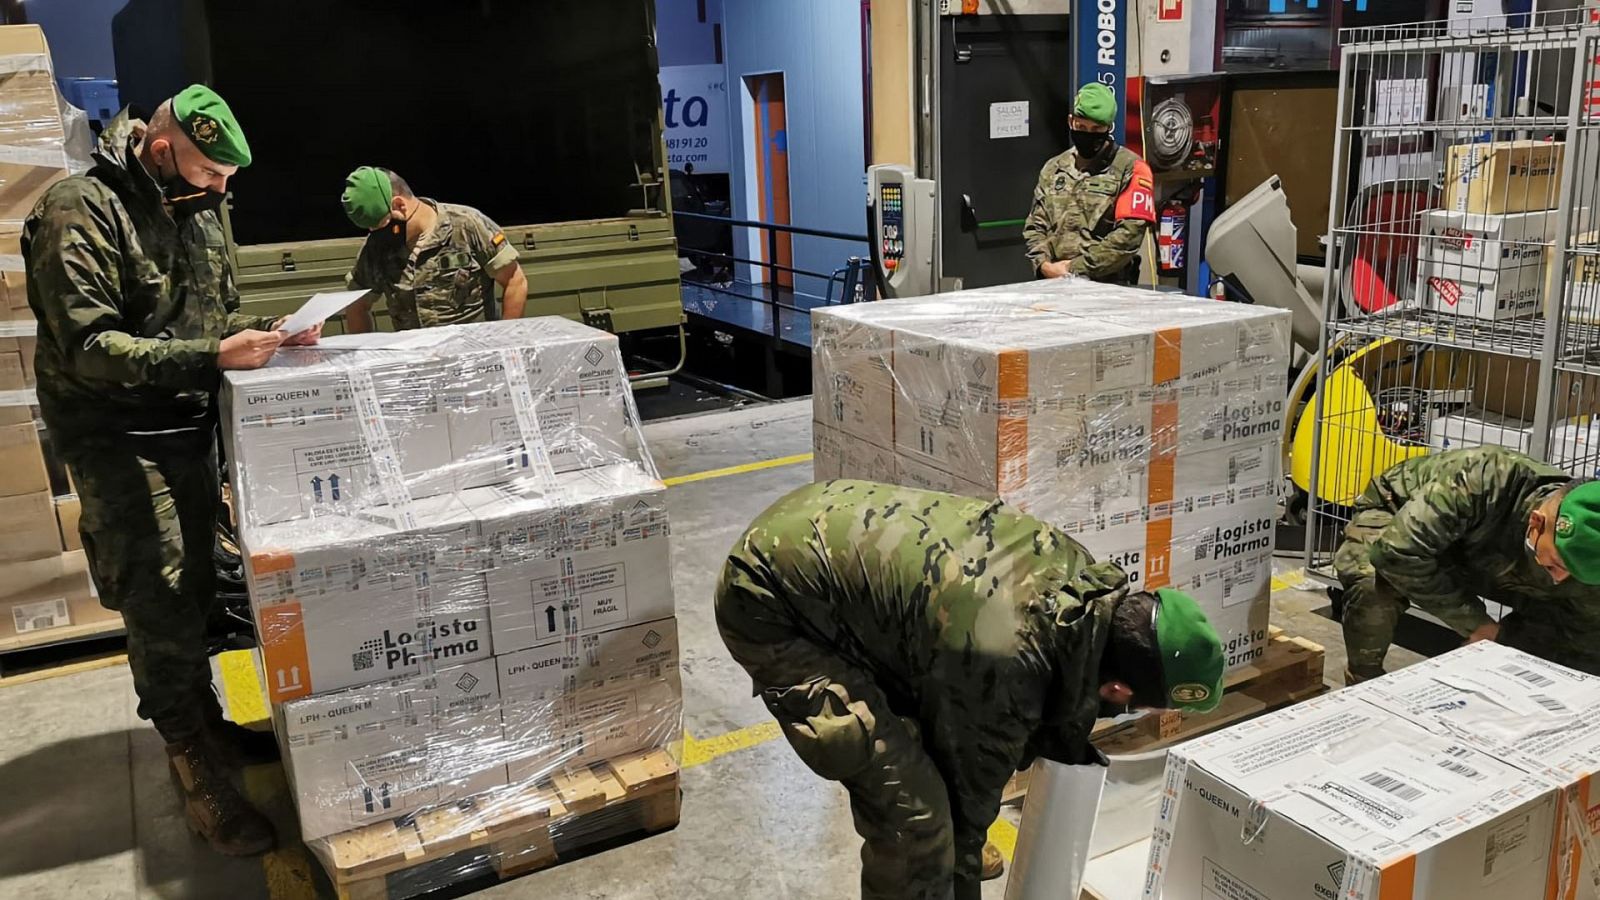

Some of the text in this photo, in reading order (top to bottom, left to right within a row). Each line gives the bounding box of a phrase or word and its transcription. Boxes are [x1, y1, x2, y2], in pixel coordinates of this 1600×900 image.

[664, 89, 708, 128] ta
[667, 137, 708, 149] 819120
[248, 393, 268, 405] LPH
[276, 390, 309, 403] QUEEN
[311, 388, 320, 397] M
[1223, 400, 1282, 423] Logista
[1222, 418, 1281, 441] Pharma
[1216, 518, 1271, 542] Logista
[1109, 552, 1140, 567] ista
[1214, 536, 1270, 560] Pharma
[597, 598, 613, 607] MUY
[1222, 628, 1264, 653] ogista
[385, 639, 479, 670] Phrma
[1225, 645, 1264, 668] arma
[508, 664, 526, 676] LPH
[532, 657, 561, 670] QUEEN
[300, 713, 320, 725] LPH
[328, 704, 362, 719] QUEEN
[364, 701, 372, 711] M
[1199, 788, 1229, 812] QUEEN
[1231, 807, 1239, 818] M
